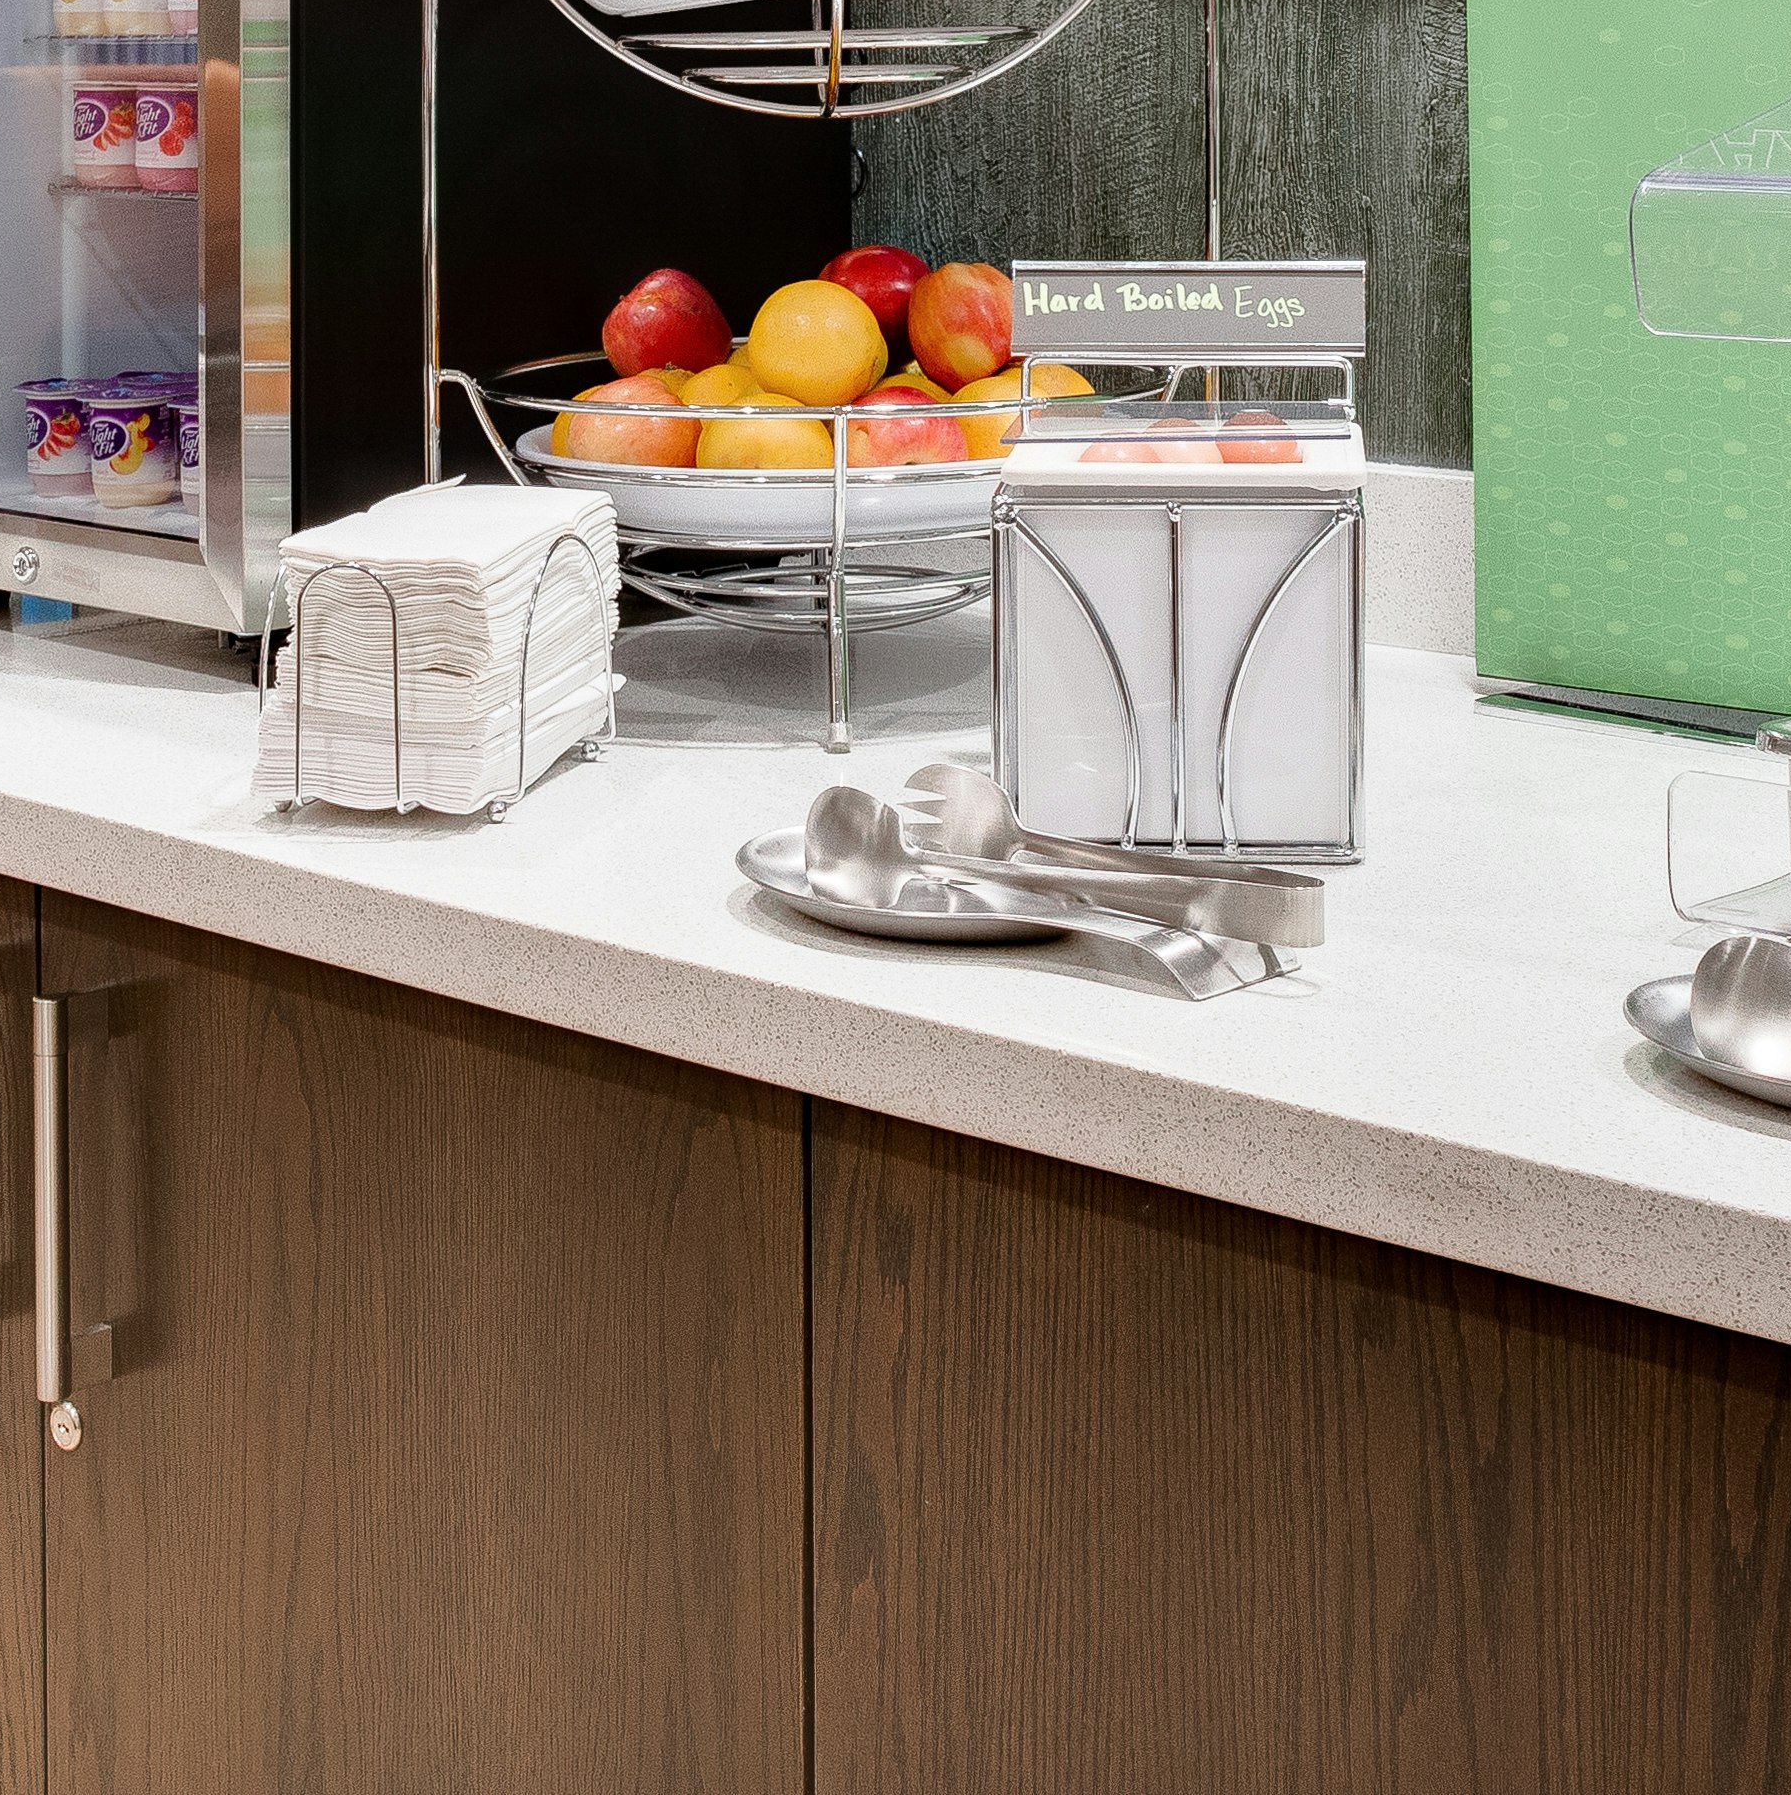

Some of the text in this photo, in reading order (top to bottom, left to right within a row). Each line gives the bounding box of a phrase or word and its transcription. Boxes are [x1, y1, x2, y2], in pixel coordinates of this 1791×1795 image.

[1022, 281, 1306, 329] Hard Boiled Eggs
